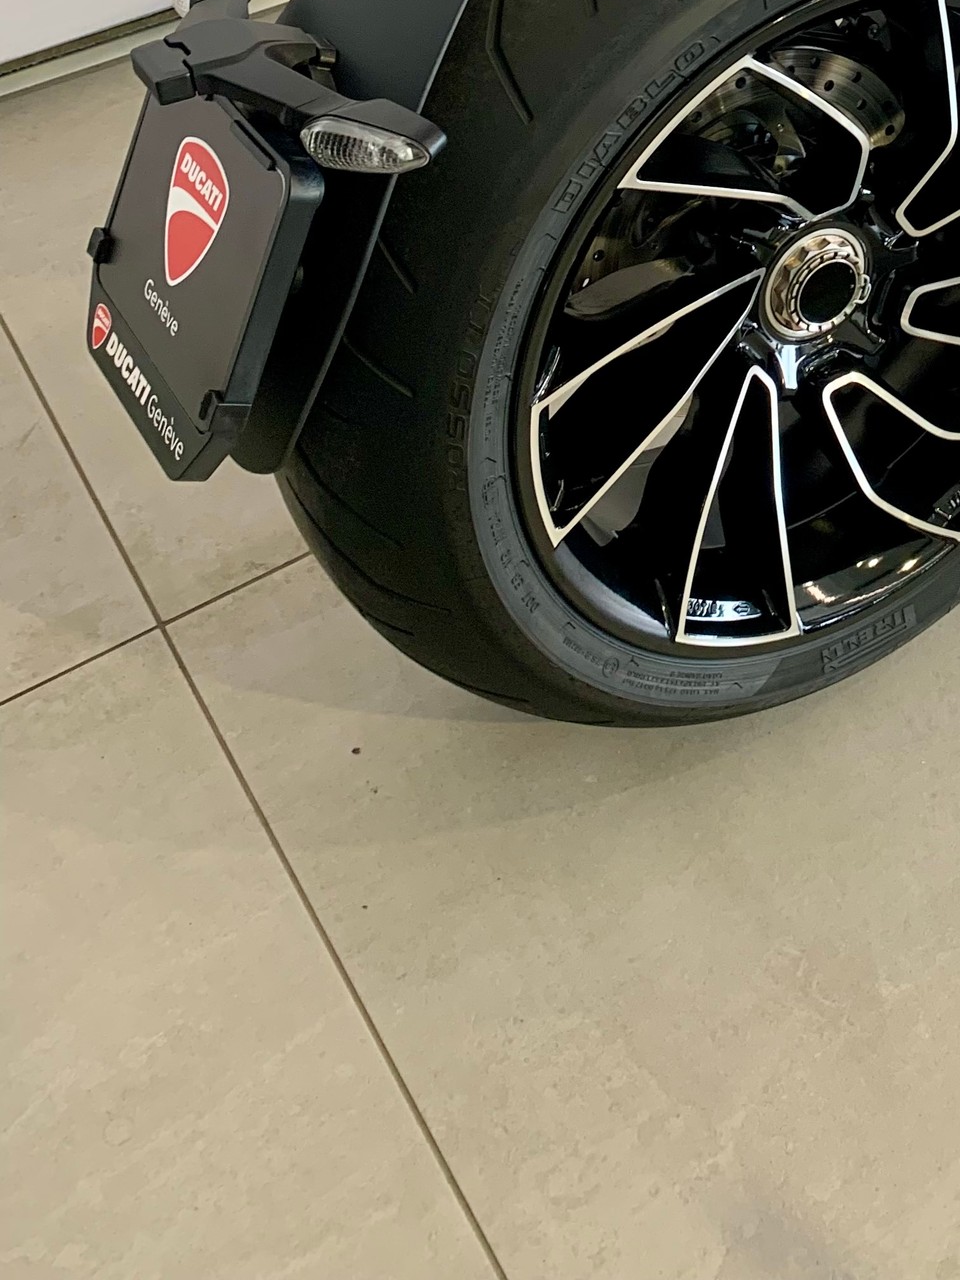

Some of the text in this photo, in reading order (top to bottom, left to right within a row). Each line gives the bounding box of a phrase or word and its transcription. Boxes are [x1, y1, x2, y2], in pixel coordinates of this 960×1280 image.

[551, 40, 706, 214] DIABLO
[180, 152, 223, 212] DUCATI
[143, 277, 179, 338] Genève
[105, 332, 185, 462] DUCATI Genève
